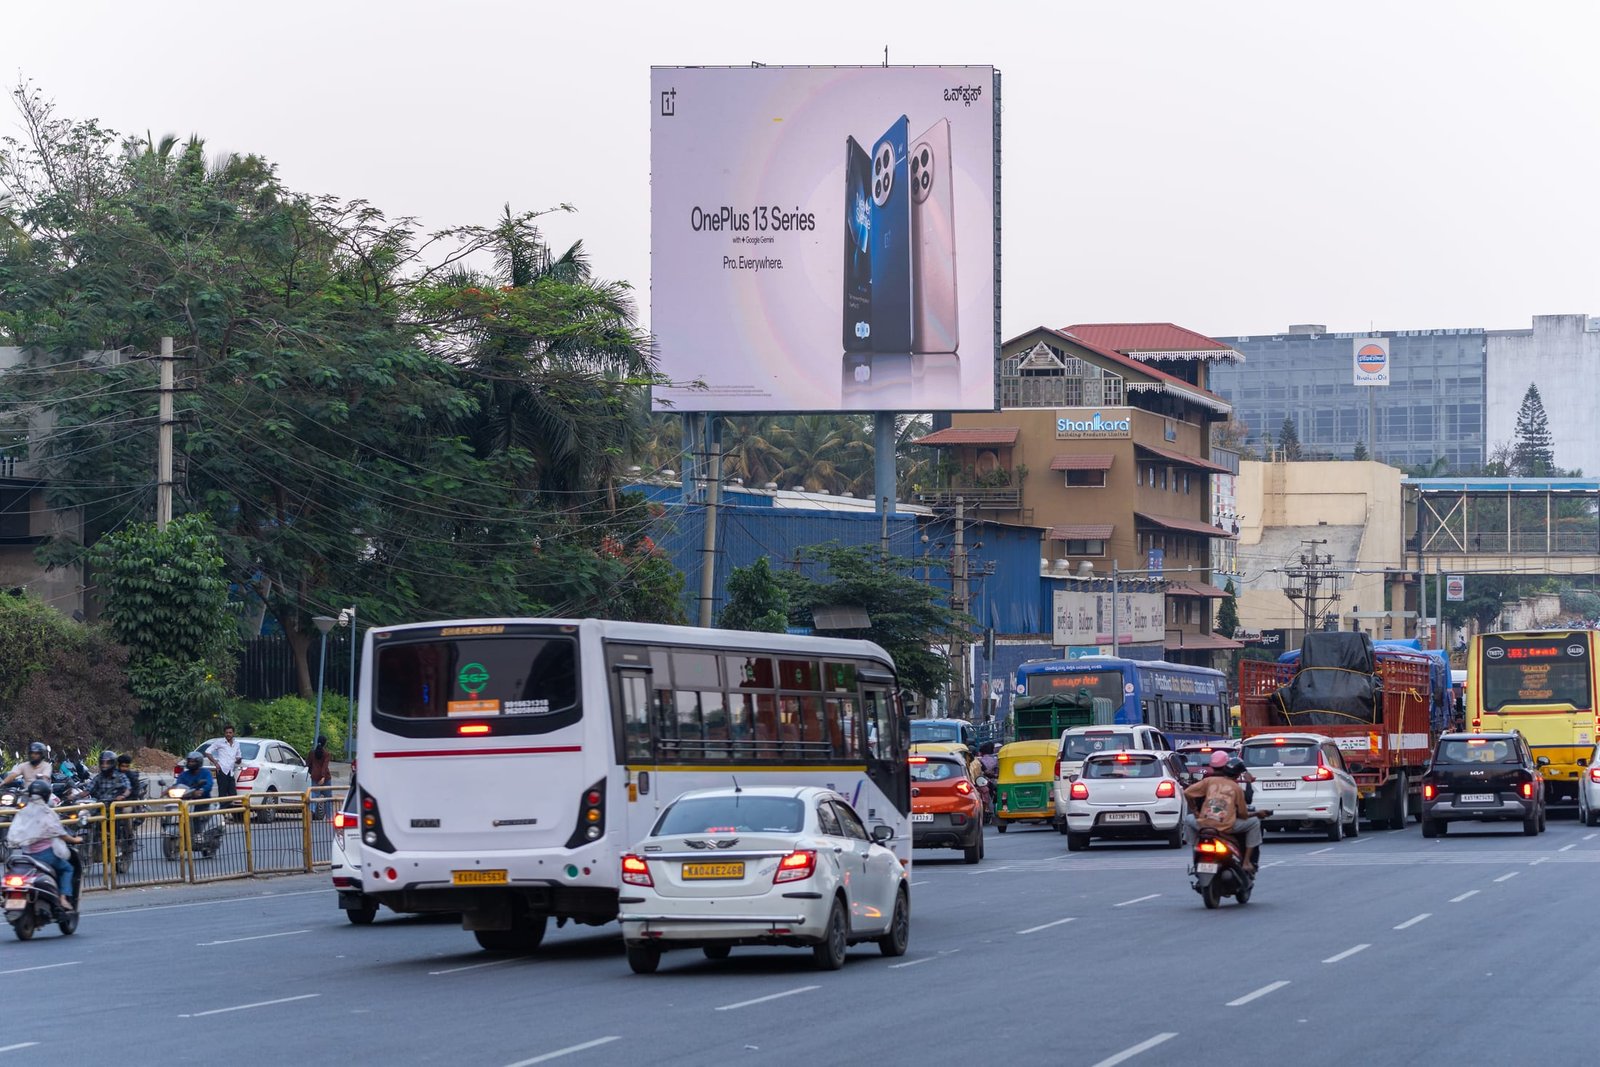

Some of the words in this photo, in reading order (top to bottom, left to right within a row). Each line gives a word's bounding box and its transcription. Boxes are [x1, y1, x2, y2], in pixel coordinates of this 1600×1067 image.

[691, 206, 750, 231] OnePlus
[752, 206, 768, 231] 13
[771, 205, 816, 231] Series
[732, 236, 741, 244] with
[745, 235, 760, 245] Google
[760, 235, 775, 244] Gemini
[723, 255, 738, 269] Pro.
[739, 255, 784, 272] Everywhere.
[1057, 414, 1130, 431] Shankara
[459, 673, 489, 683] SGP
